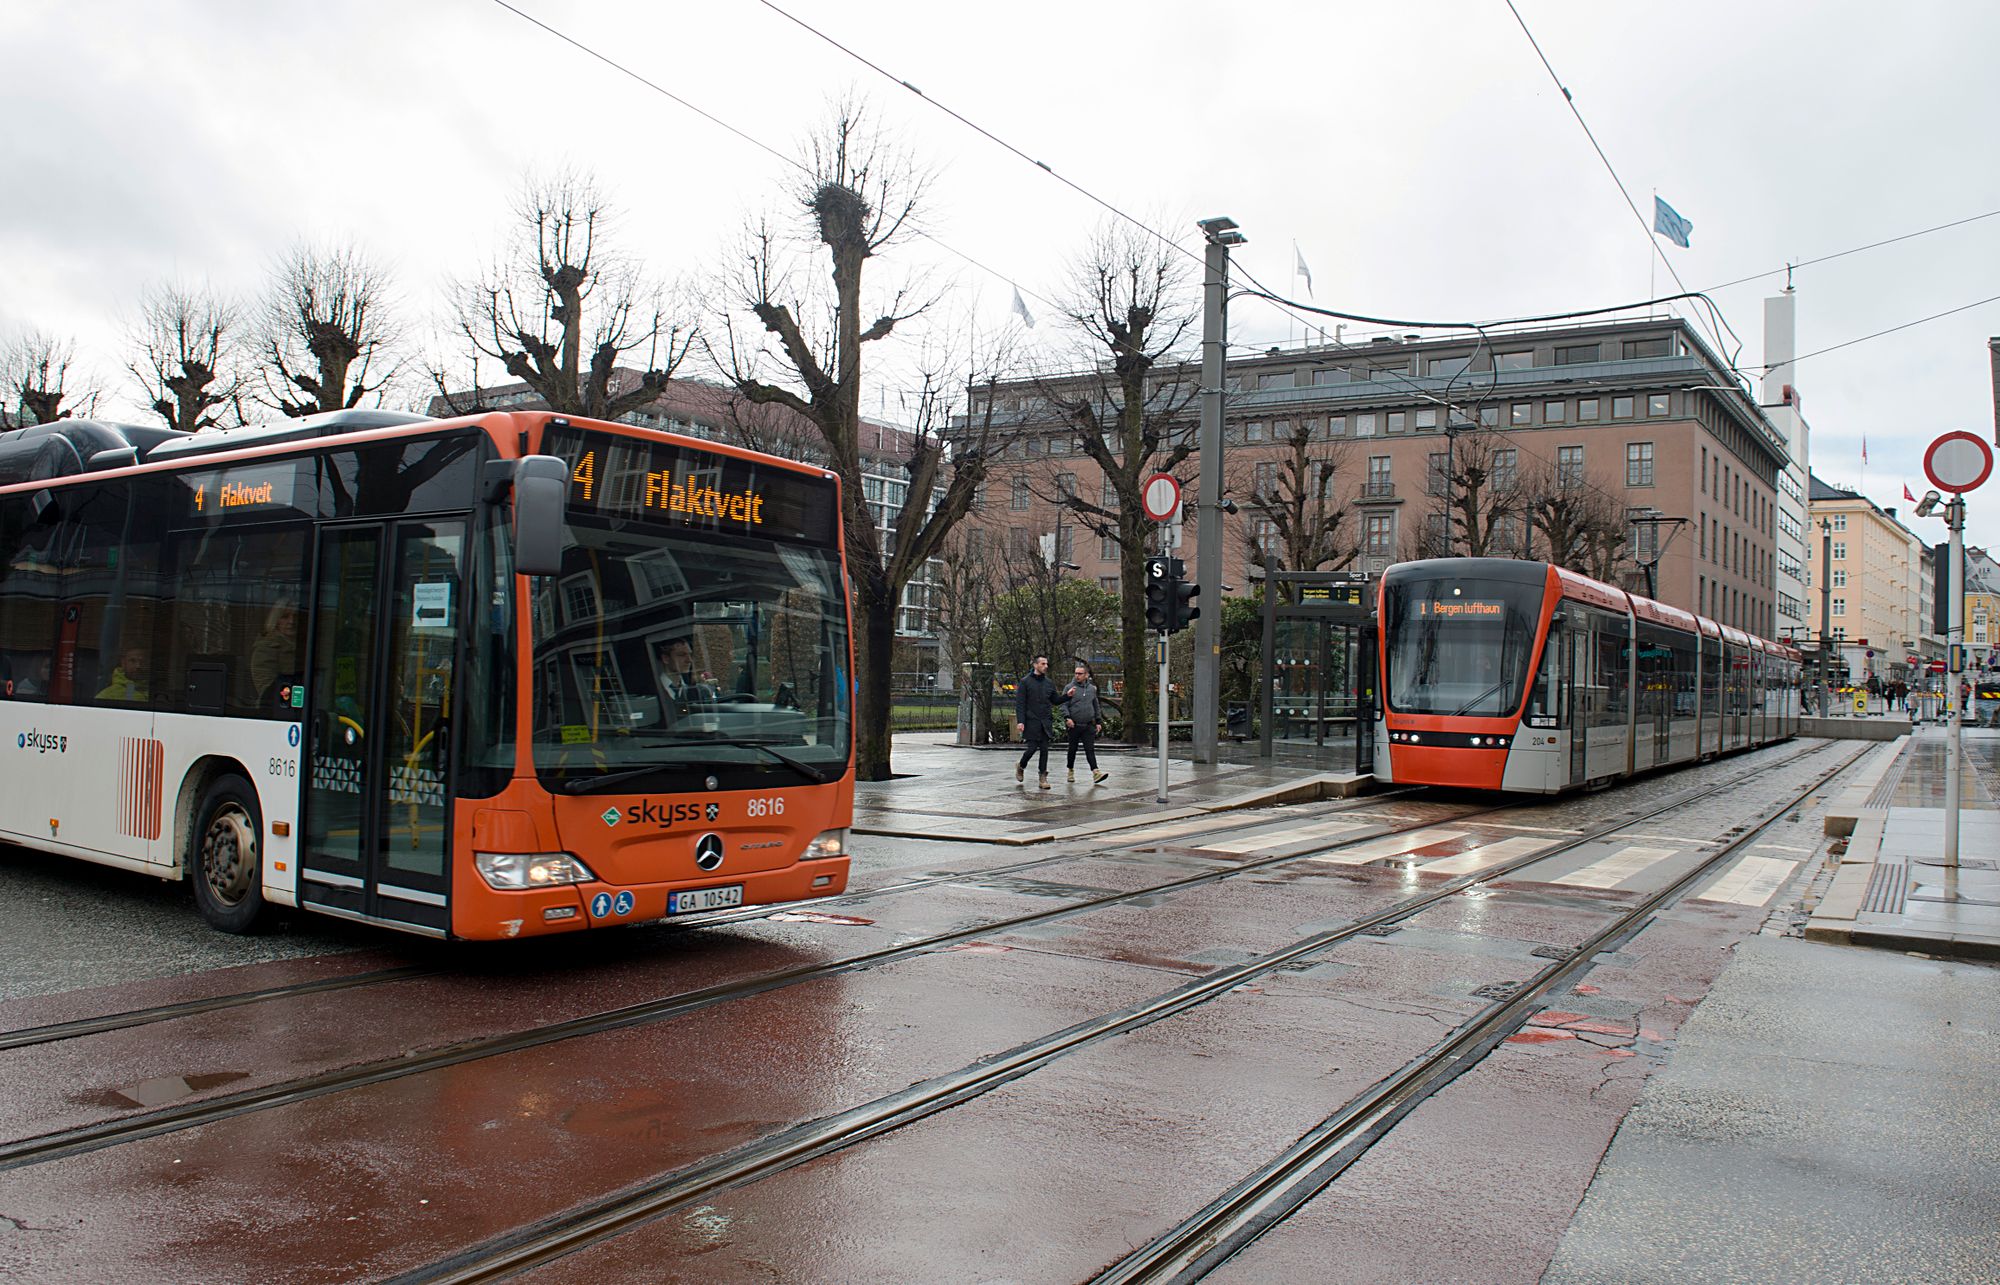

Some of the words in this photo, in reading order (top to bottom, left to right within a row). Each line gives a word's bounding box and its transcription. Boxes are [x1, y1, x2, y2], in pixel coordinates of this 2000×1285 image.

[194, 483, 204, 511] 4
[220, 481, 273, 508] Flaktveit
[573, 451, 594, 500] 4
[645, 470, 764, 524] Flaktveit
[1153, 563, 1162, 577] S
[1363, 572, 1369, 580] 1
[1421, 602, 1426, 615] 1
[1434, 601, 1463, 616] Bergen
[27, 727, 59, 754] skyss
[1532, 737, 1545, 746] 204
[269, 757, 296, 778] 8616
[627, 798, 700, 828] skyss
[747, 797, 785, 818] 8616
[680, 894, 697, 910] GA
[704, 888, 739, 907] 10542
